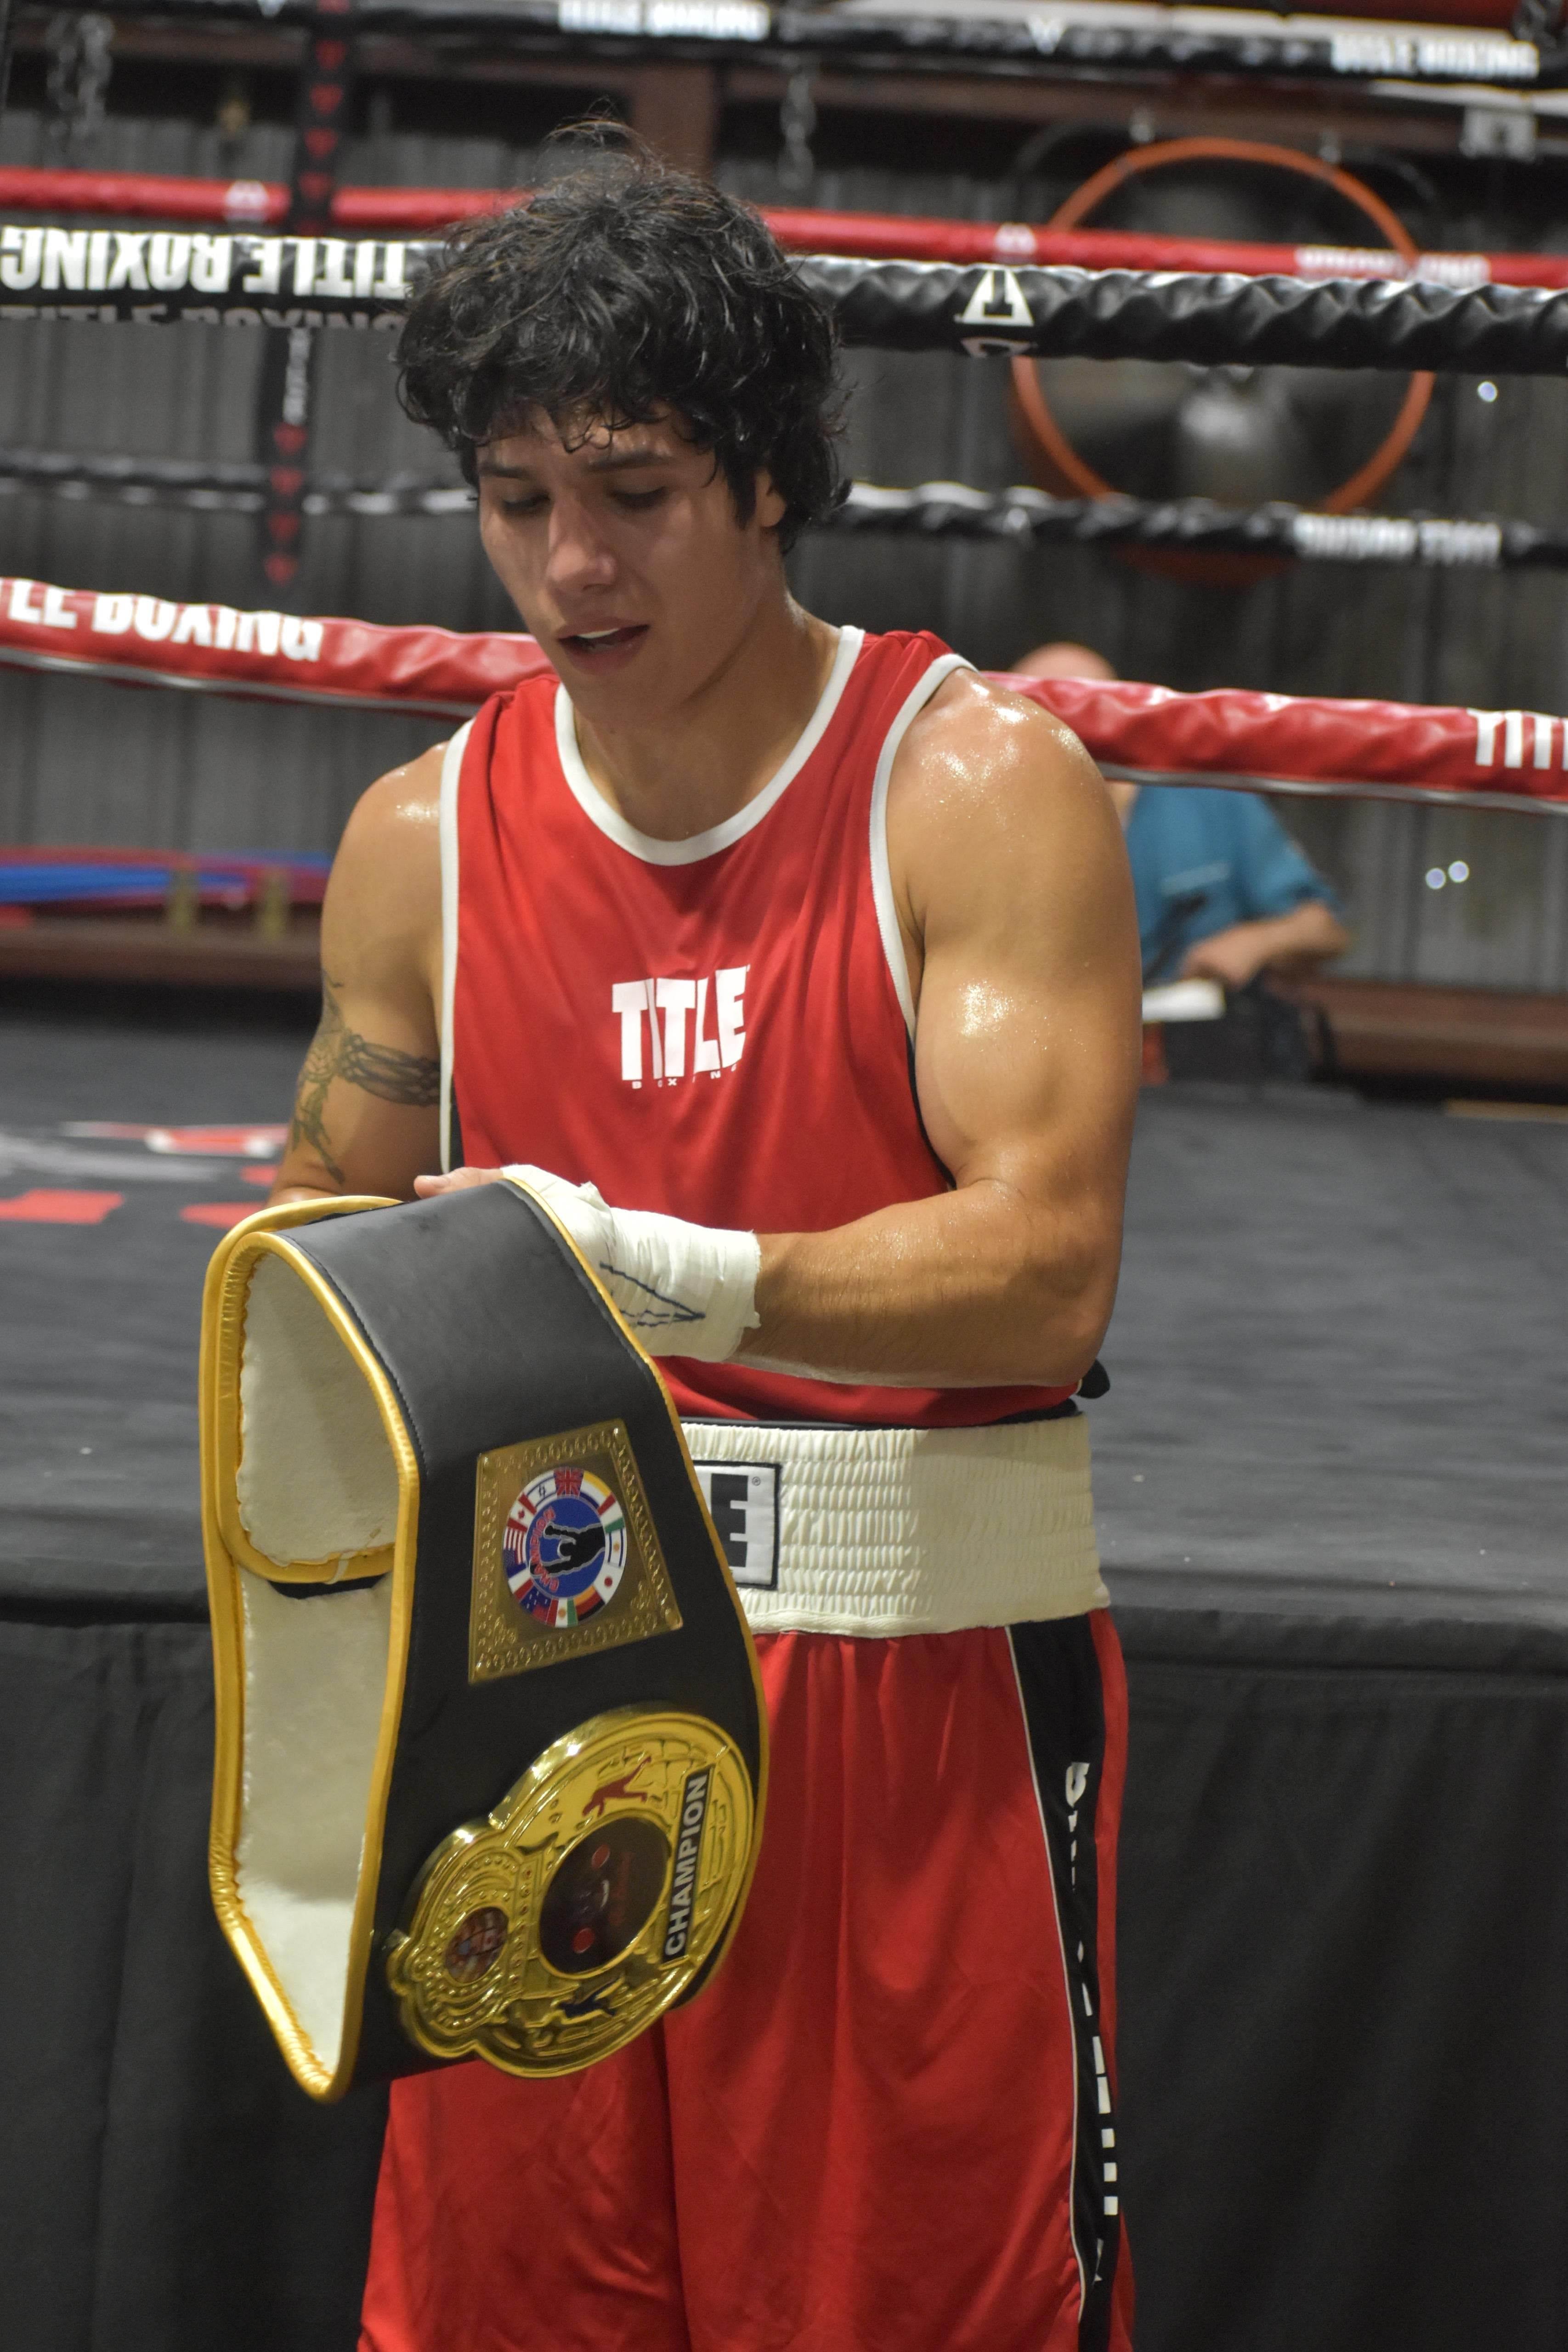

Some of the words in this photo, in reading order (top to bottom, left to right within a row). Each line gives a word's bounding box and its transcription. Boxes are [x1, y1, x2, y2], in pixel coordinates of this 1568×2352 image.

[243, 236, 413, 299] TITLE
[612, 966, 747, 1081] TITLE
[665, 1774, 708, 1956] CHAMPION
